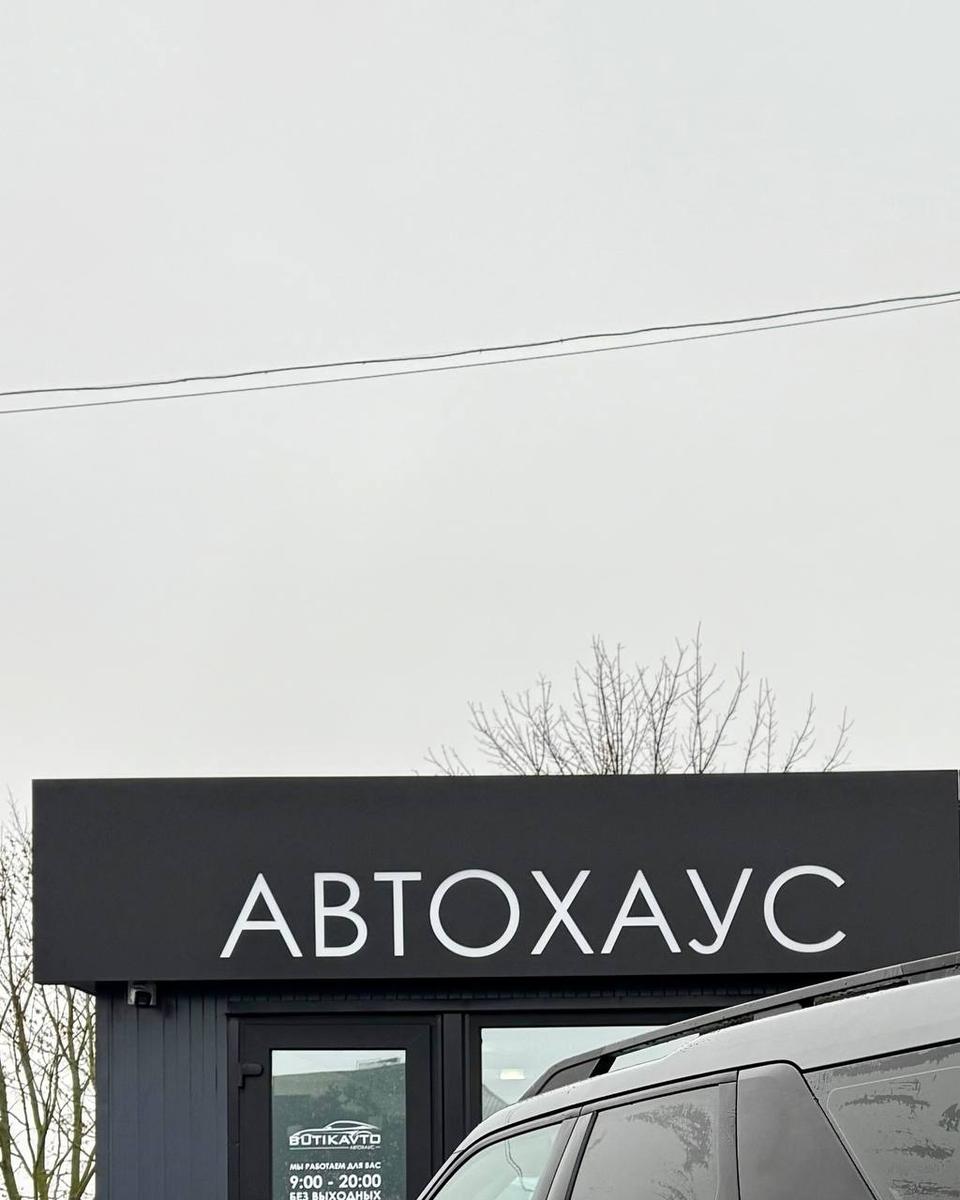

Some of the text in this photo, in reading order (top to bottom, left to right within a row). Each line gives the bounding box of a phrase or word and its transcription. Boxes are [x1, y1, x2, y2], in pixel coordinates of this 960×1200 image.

[220, 865, 847, 960] АВТОХАУС
[289, 1133, 381, 1147] BUTIKAVTO
[289, 1161, 381, 1171] МЫ РАБОТАЕМ ДЛЯ ВАС
[289, 1175, 323, 1189] 9:00
[338, 1174, 382, 1189] 20:00
